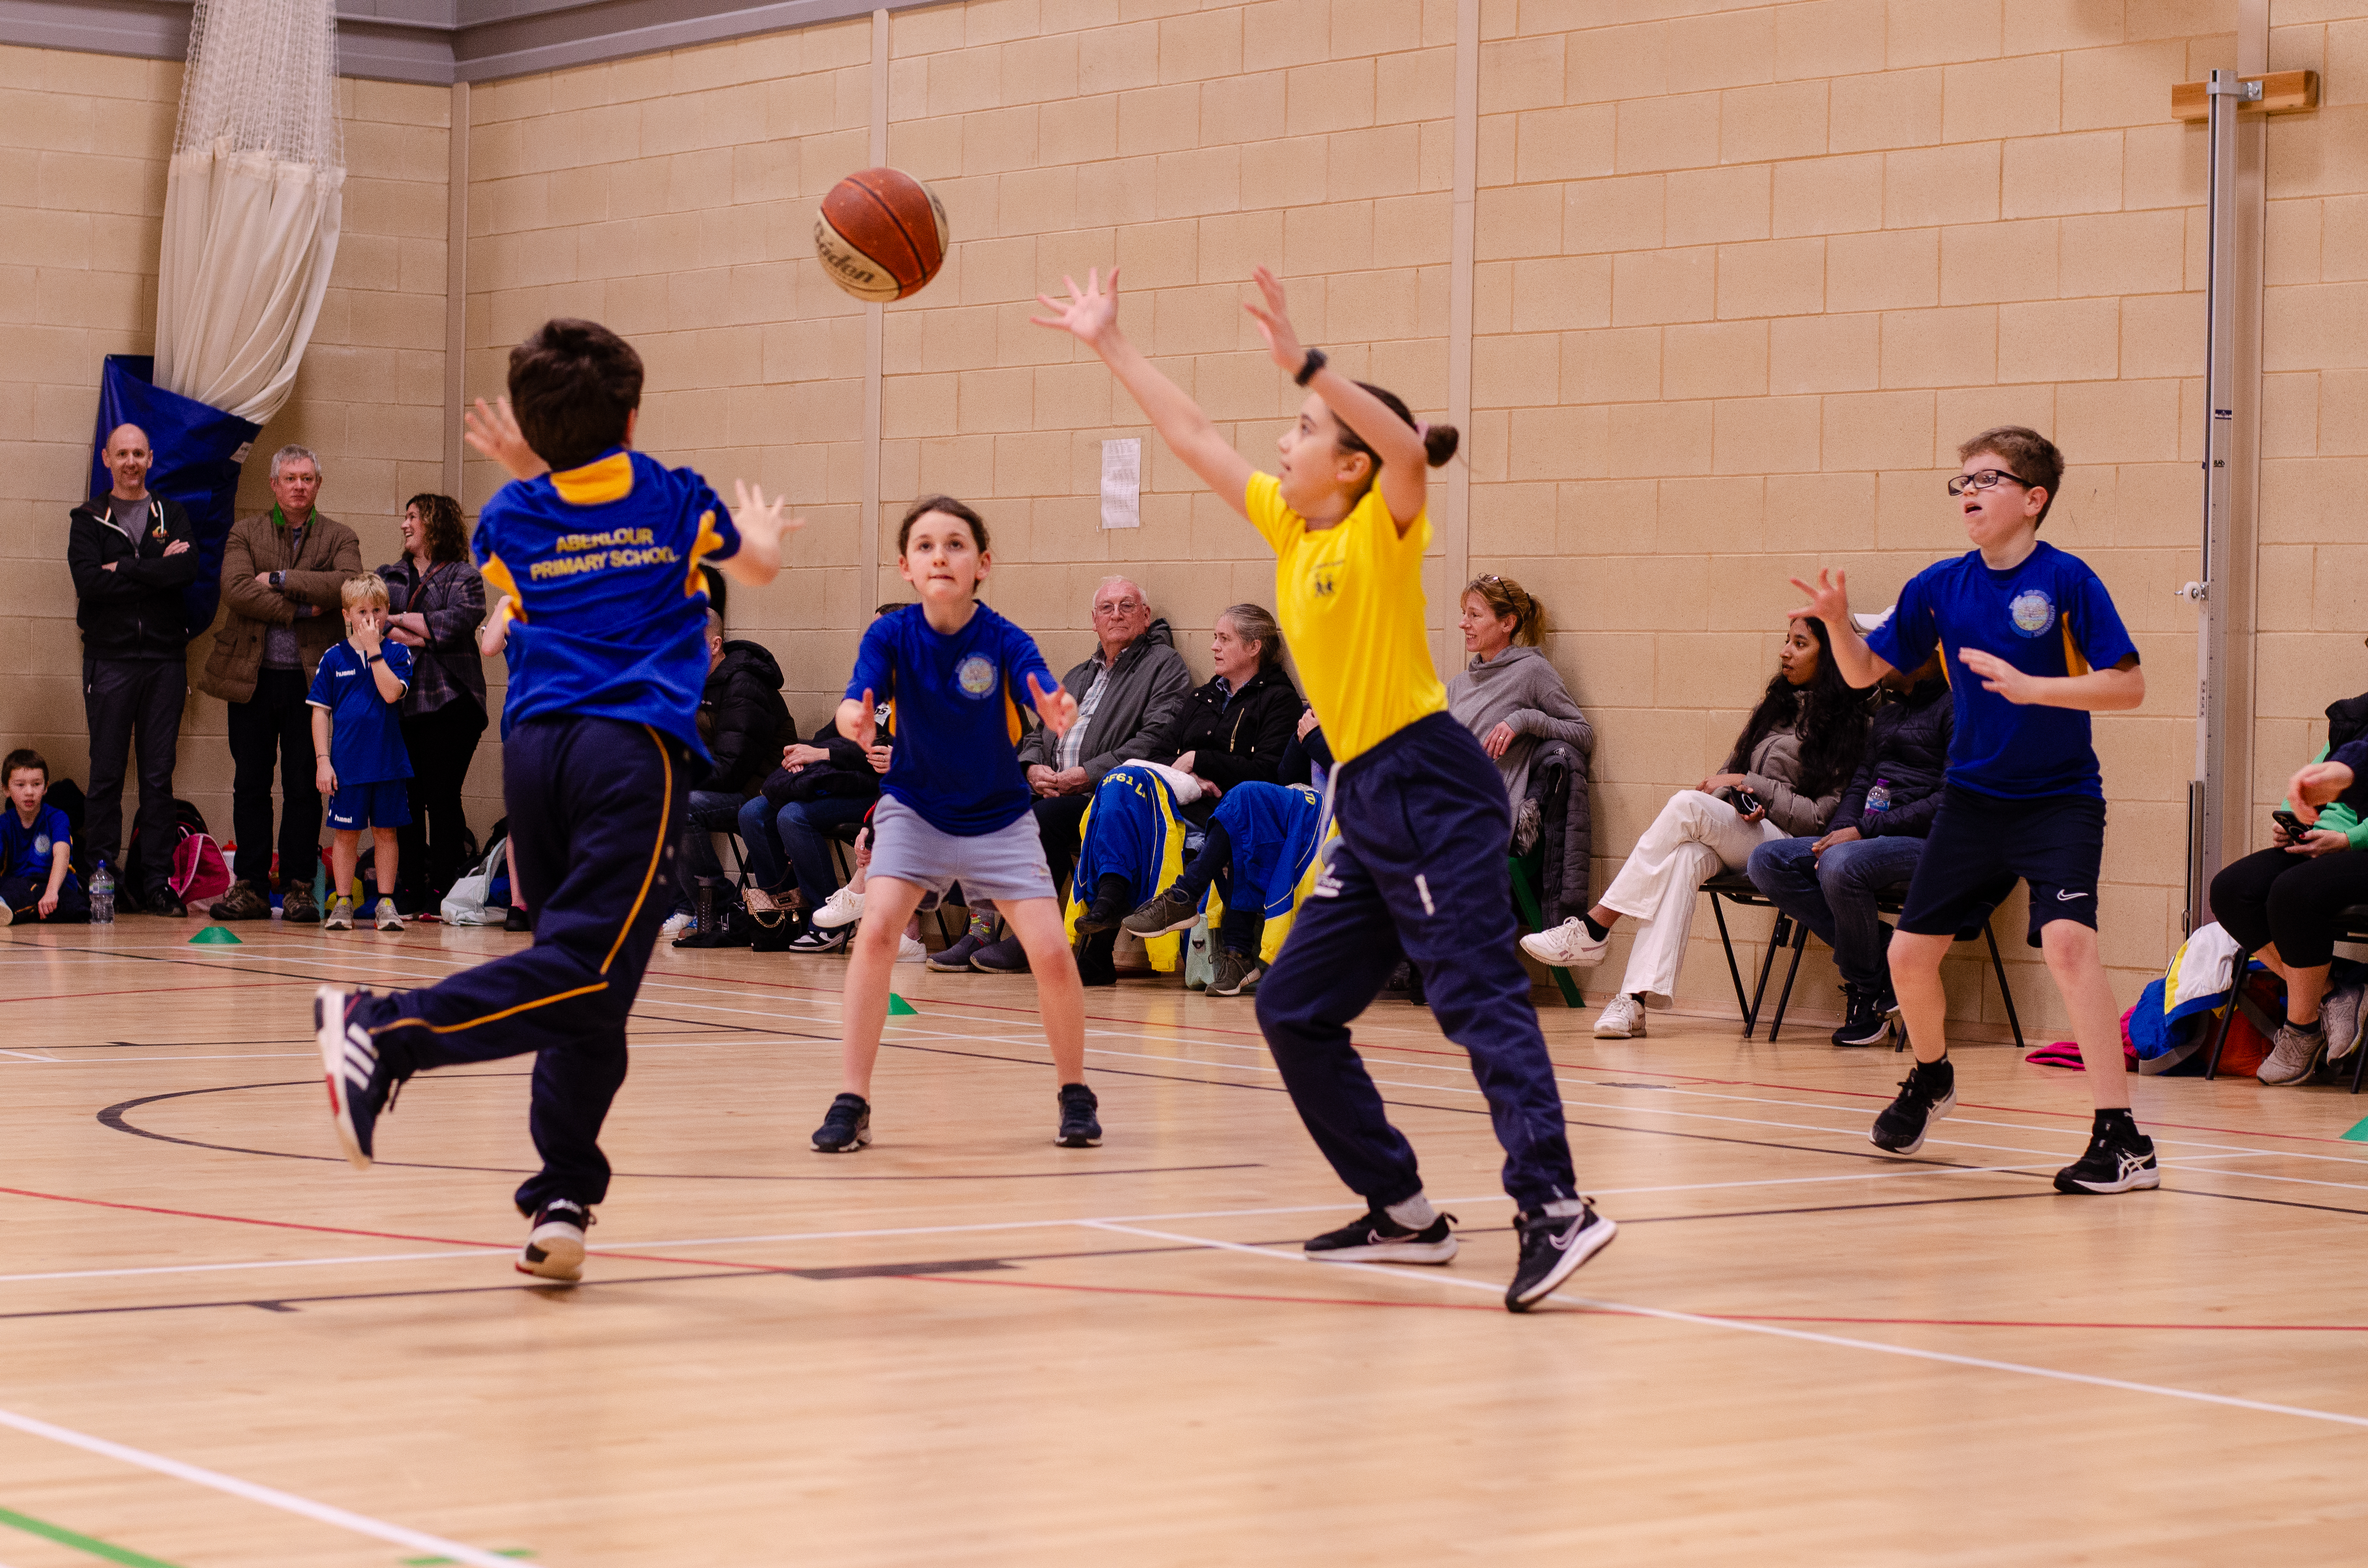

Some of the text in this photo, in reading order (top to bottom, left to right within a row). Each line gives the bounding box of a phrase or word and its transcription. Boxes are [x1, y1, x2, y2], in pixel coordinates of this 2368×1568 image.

[556, 527, 654, 553] ABERLOUR
[530, 546, 680, 581] PRIMARY SCHOOL
